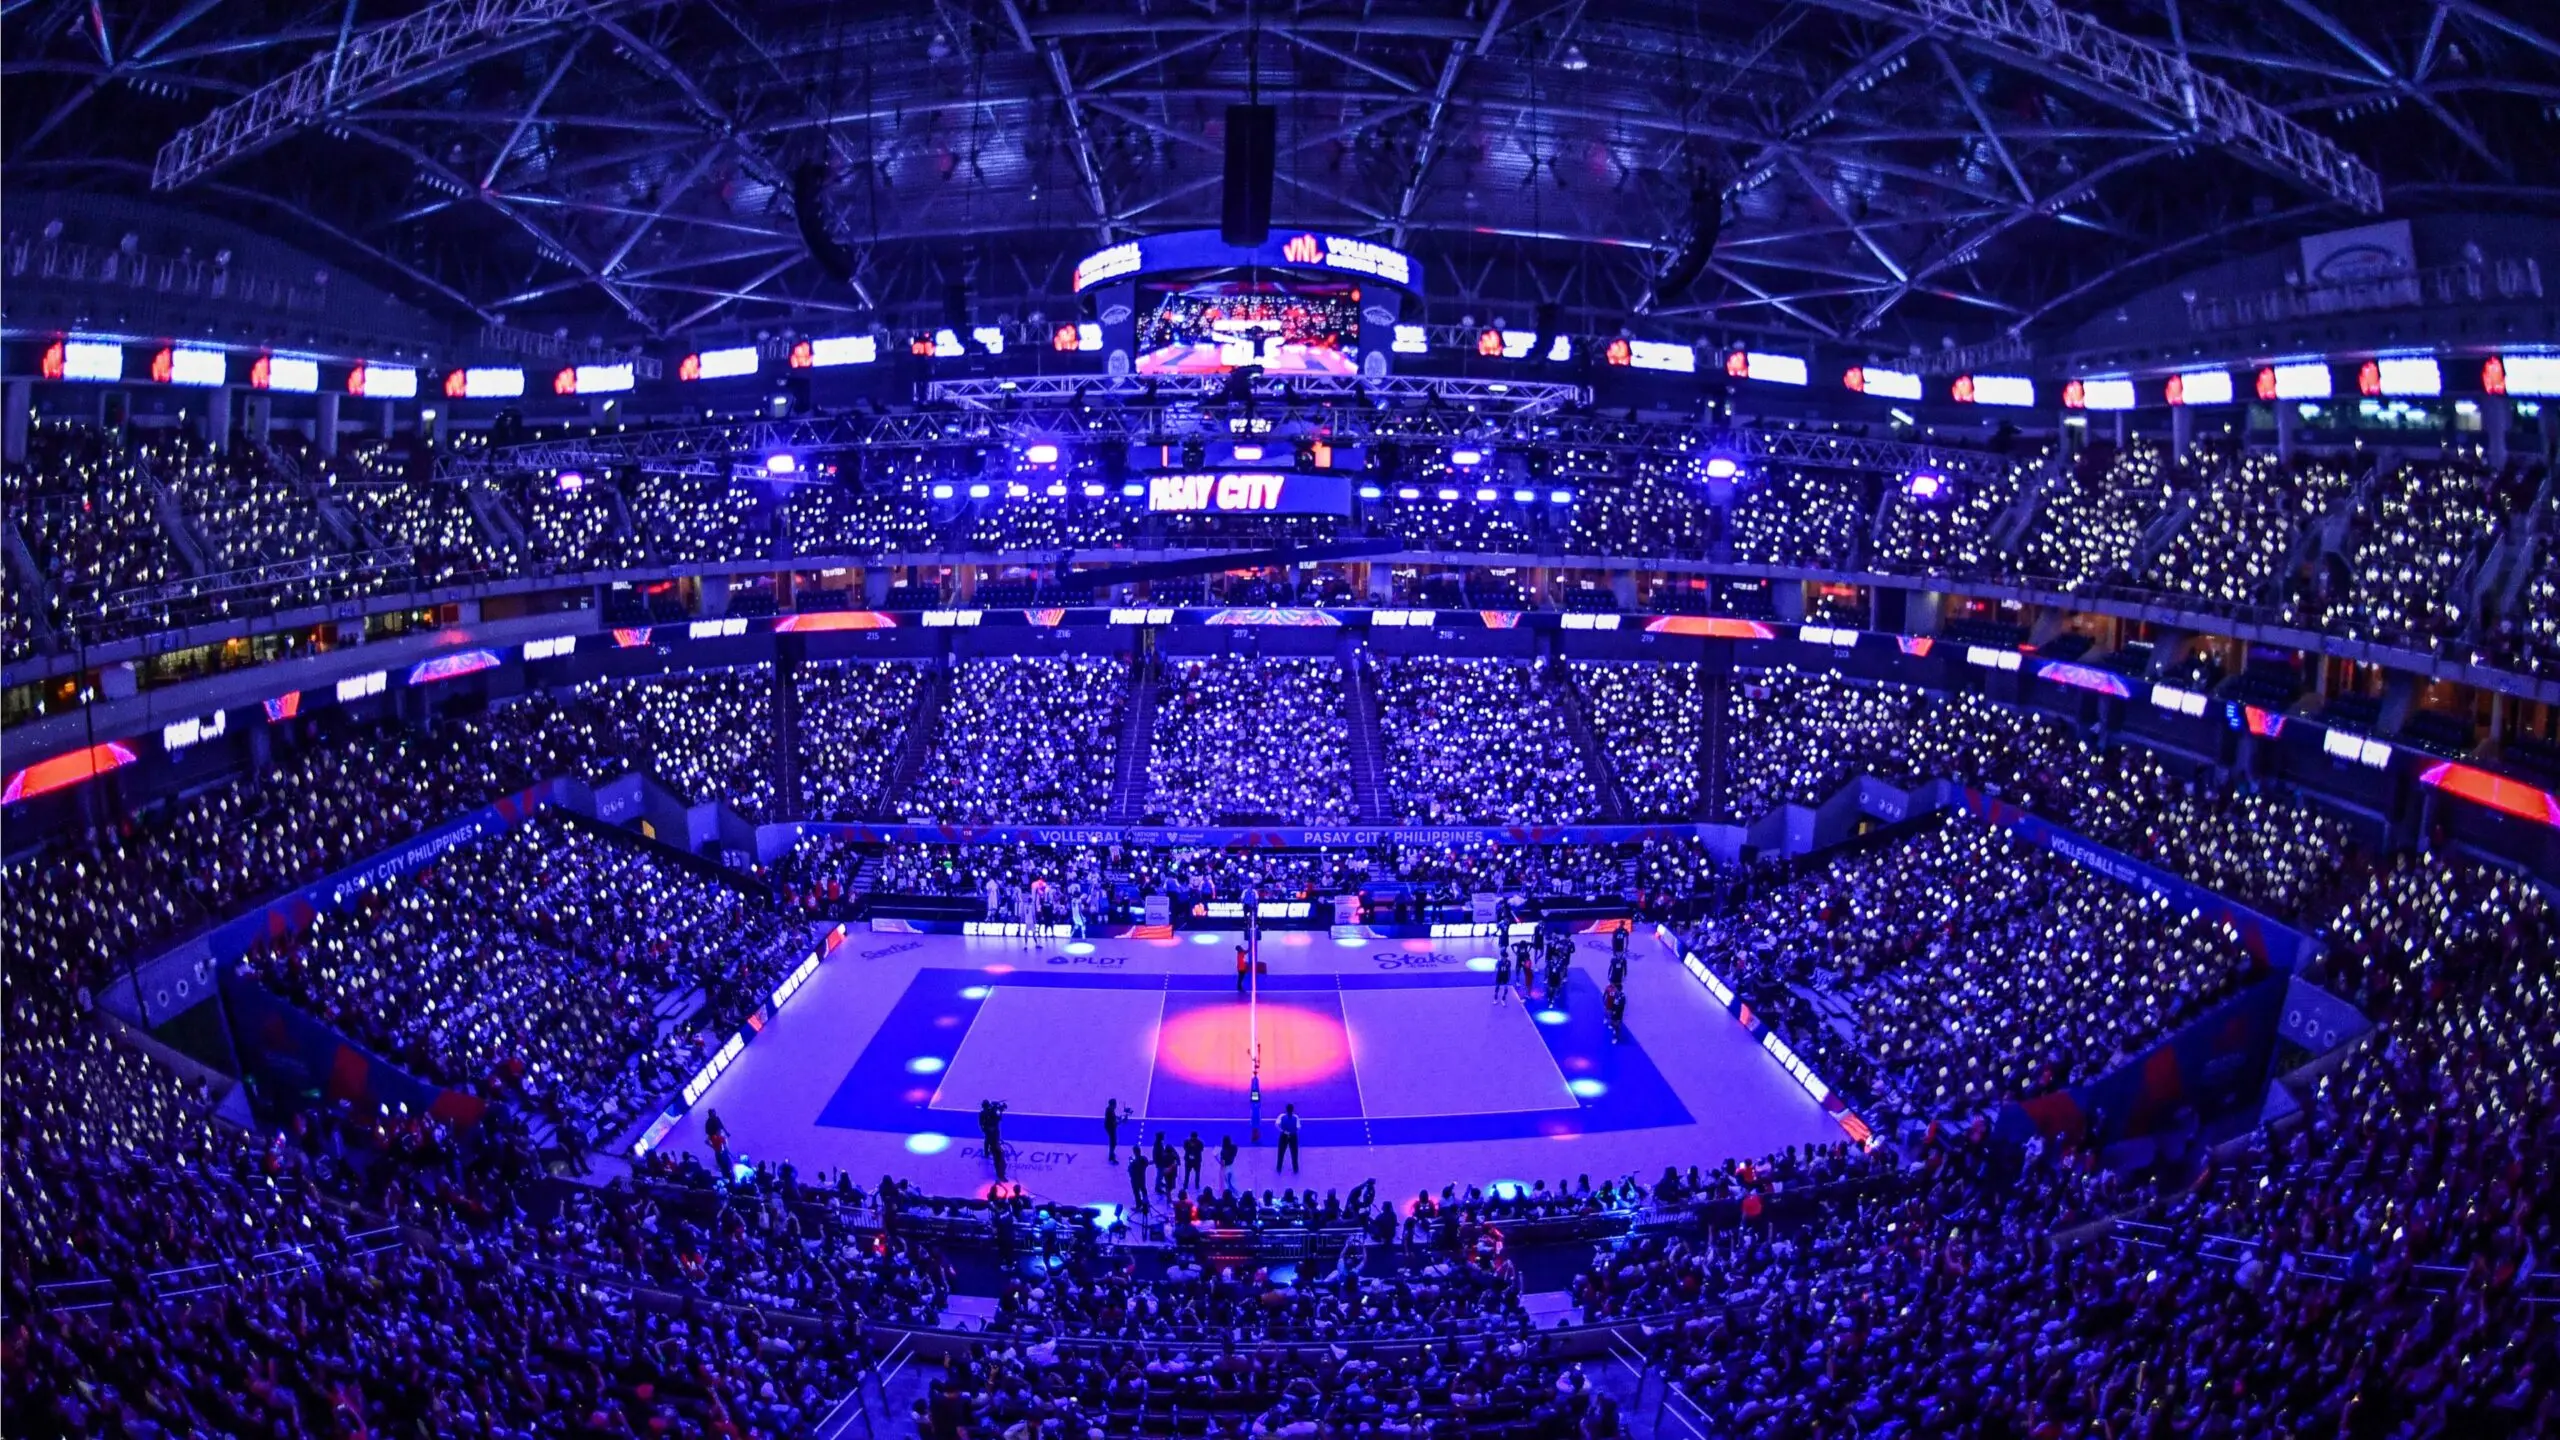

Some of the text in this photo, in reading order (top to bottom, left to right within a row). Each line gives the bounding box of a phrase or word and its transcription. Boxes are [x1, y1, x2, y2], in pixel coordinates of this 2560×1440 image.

[1216, 474, 1285, 510] CITY
[866, 632, 880, 640] 215
[1040, 830, 1129, 843] VOLLEYBAL
[1304, 831, 1350, 844] PASAY
[1394, 831, 1484, 843] PHILIPPINES
[377, 855, 404, 879] CITY
[406, 824, 473, 866] PHILIPPINES
[2052, 835, 2115, 876] VOLLEYBALL
[1073, 956, 1129, 965] PLDT
[1373, 952, 1458, 969] Stake
[1030, 1151, 1079, 1165] CITY
